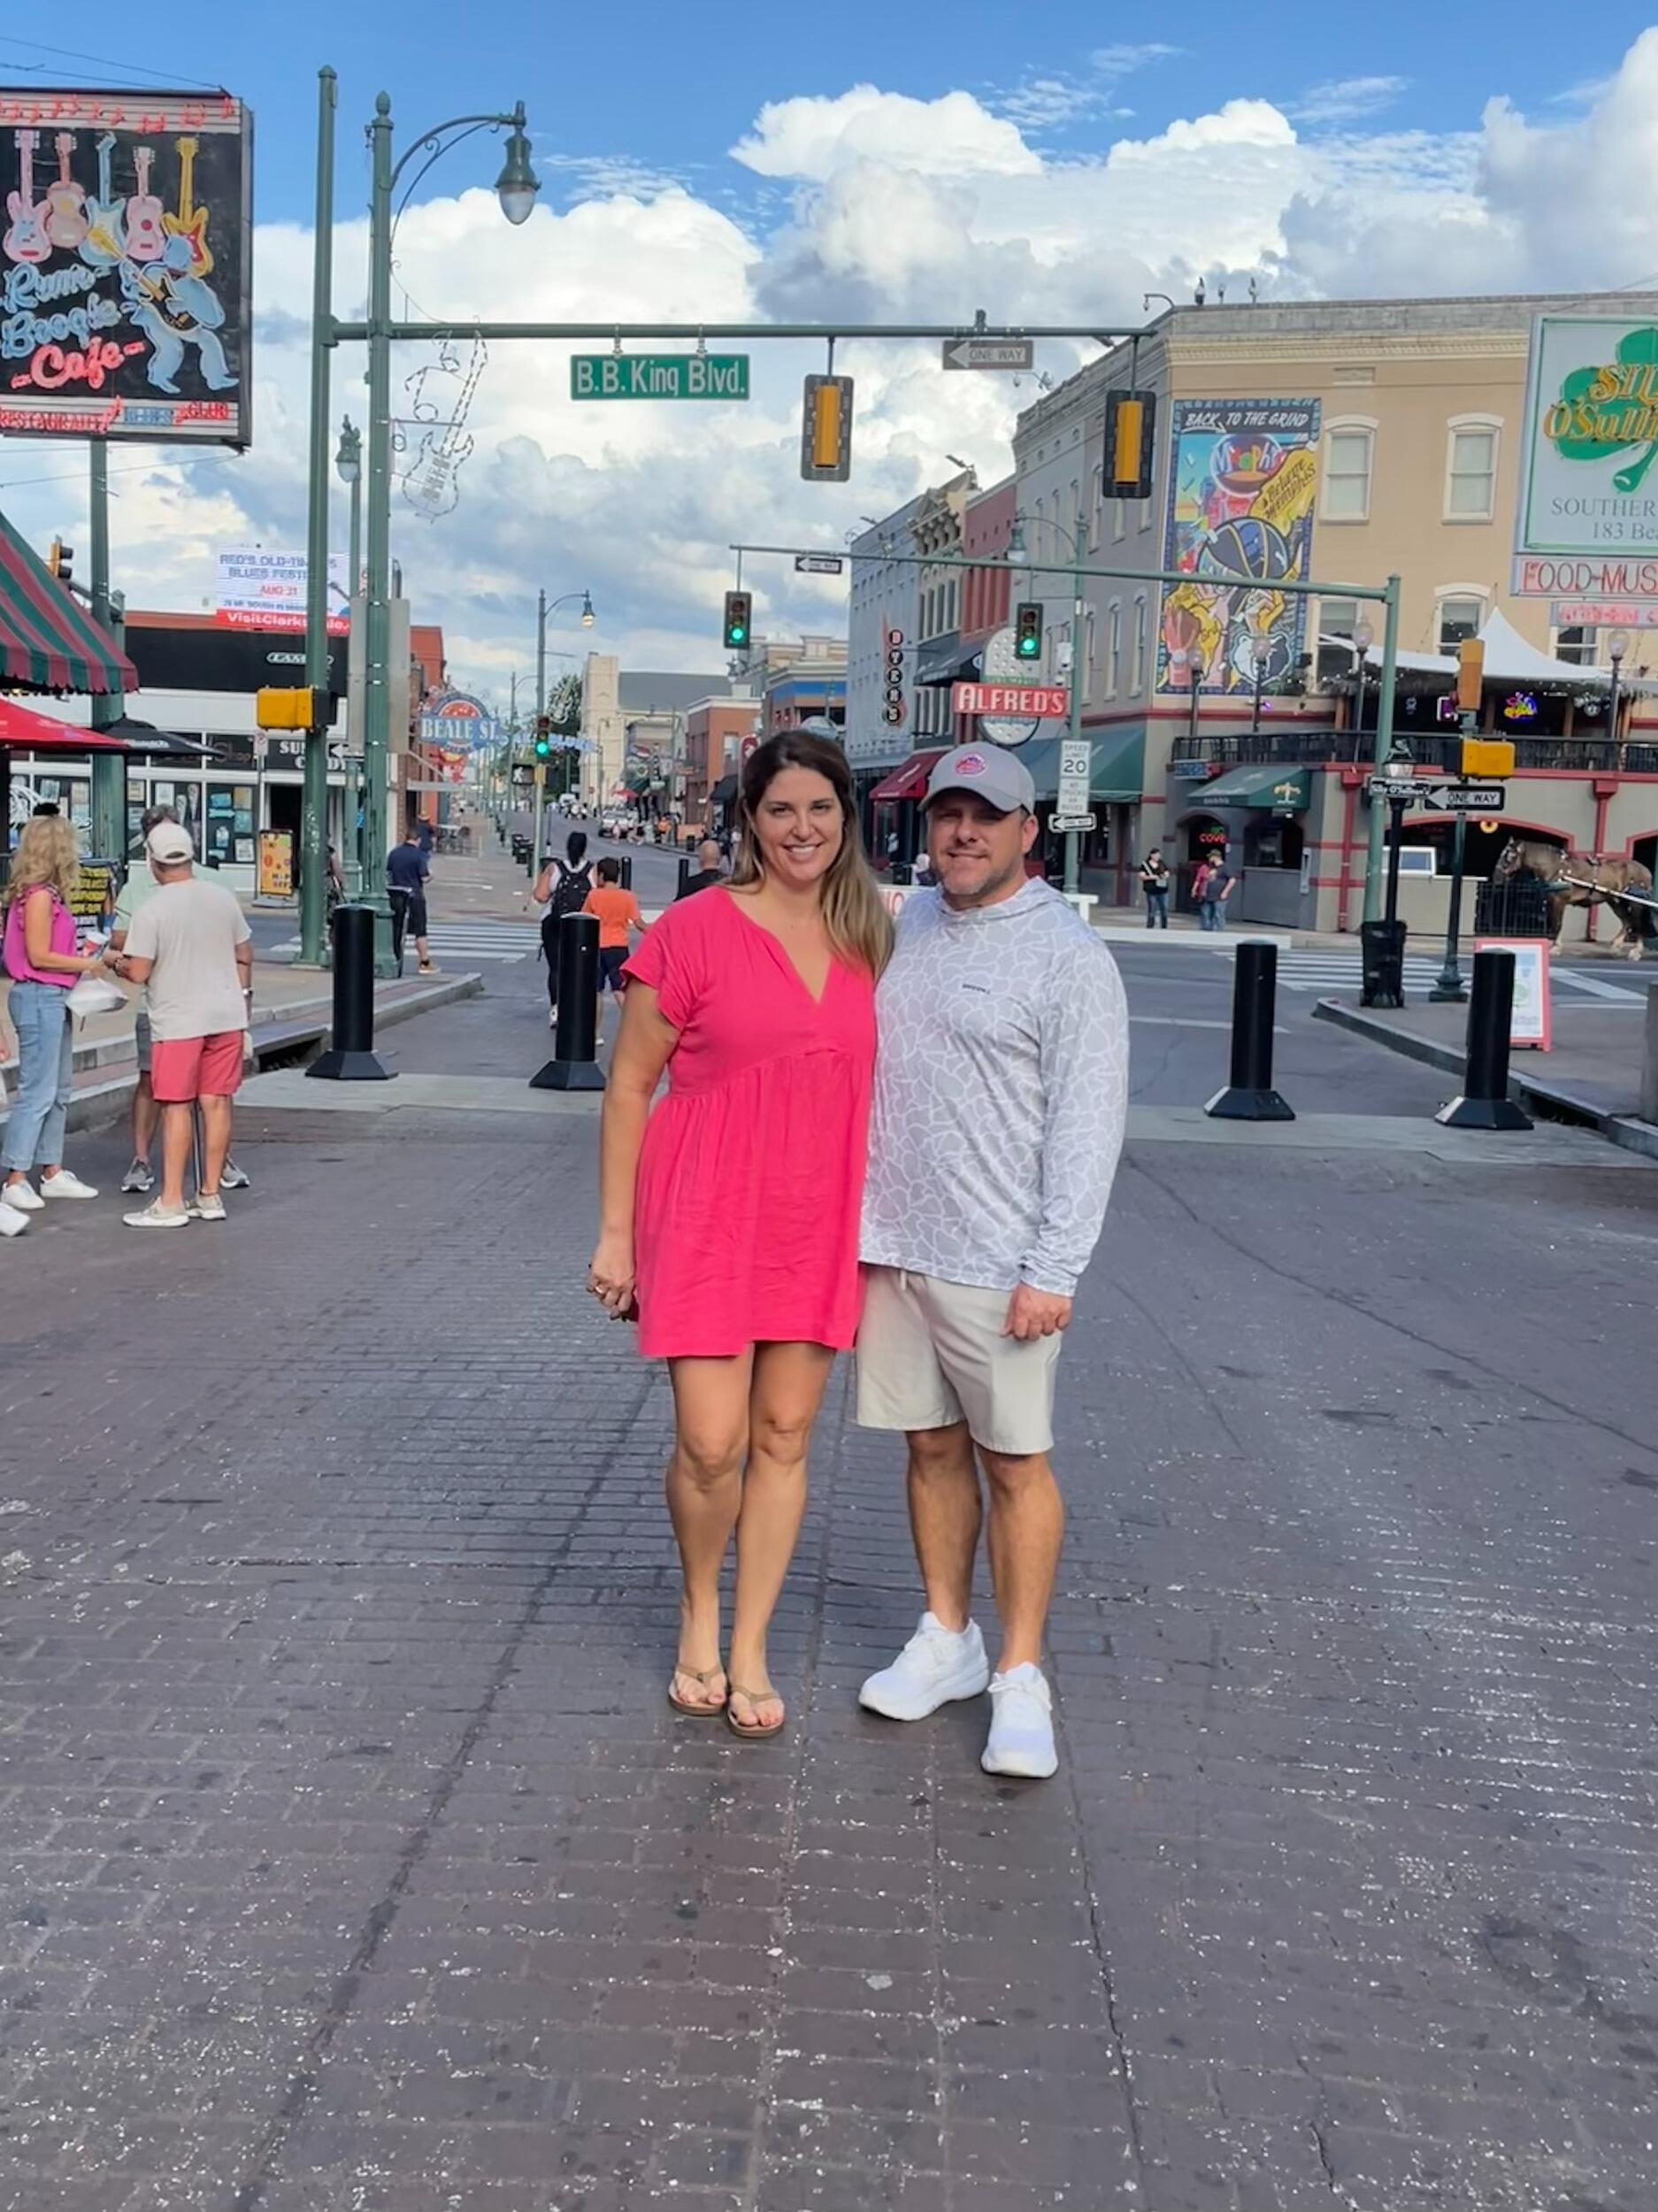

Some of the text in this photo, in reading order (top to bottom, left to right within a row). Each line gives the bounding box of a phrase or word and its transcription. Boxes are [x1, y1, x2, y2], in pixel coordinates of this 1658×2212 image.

[970, 348, 1024, 360] ONE WAY
[577, 360, 746, 396] B.B. King Blvd.
[1186, 411, 1309, 427] BACK TO THE GRIND
[1593, 522, 1623, 540] 183
[958, 685, 1064, 714] ALFRED'S
[421, 718, 473, 739] BEALE
[1063, 759, 1086, 773] 20
[1447, 791, 1497, 804] ONE WAY
